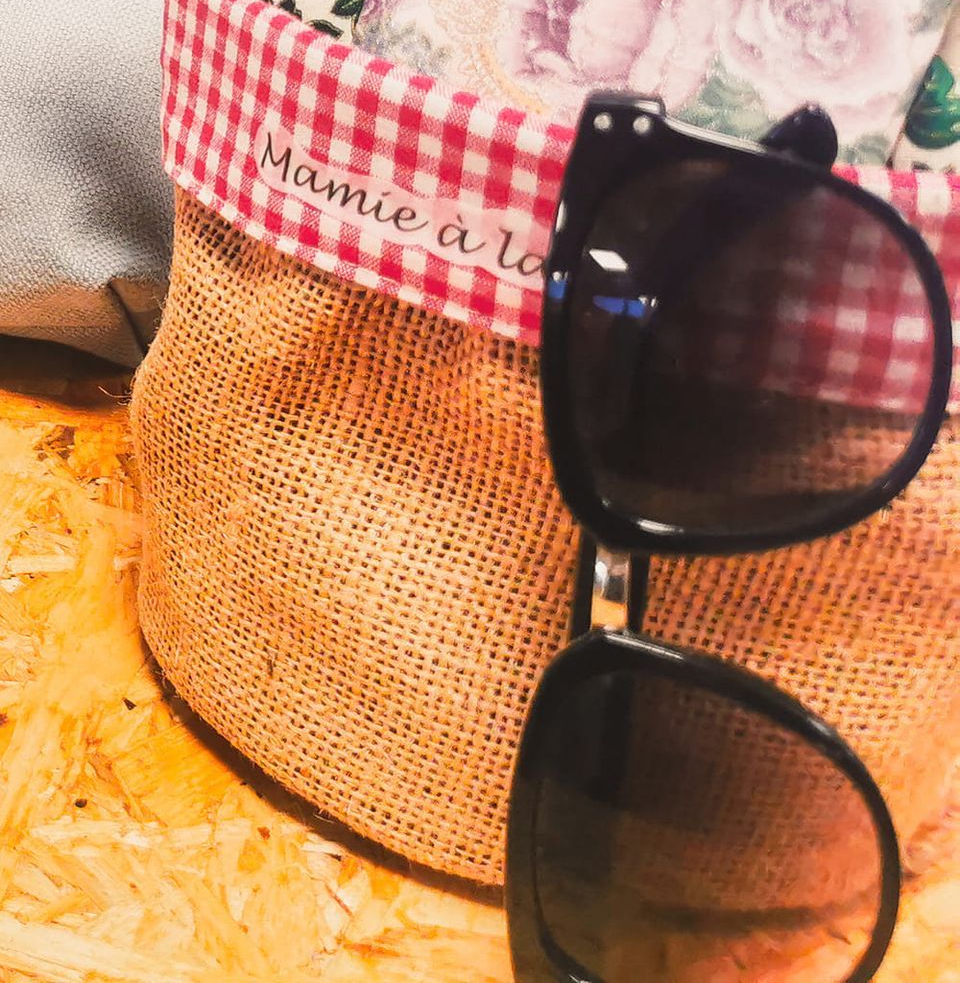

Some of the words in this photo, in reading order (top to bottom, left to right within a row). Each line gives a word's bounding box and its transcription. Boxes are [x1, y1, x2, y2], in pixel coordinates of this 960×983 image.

[260, 131, 430, 233] Mamie
[437, 214, 485, 255] à
[497, 227, 547, 278] la
